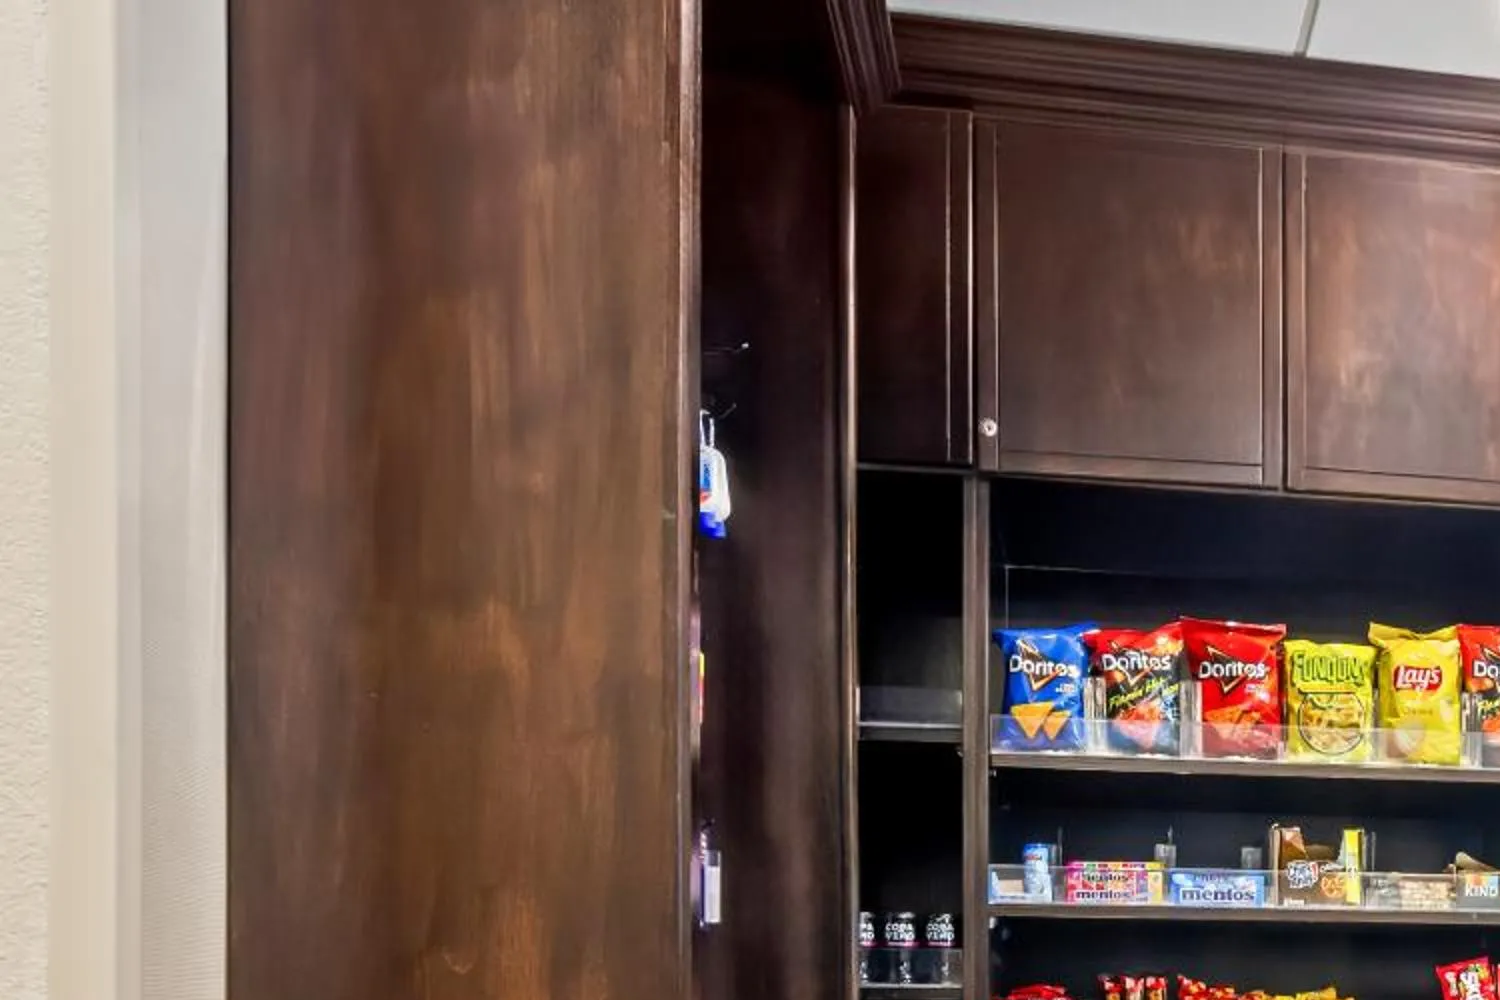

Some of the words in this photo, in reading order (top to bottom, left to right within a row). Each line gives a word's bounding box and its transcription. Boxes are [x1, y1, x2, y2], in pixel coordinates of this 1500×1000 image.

[1009, 654, 1080, 678] Doritos
[1102, 650, 1172, 672] Doritos
[1199, 658, 1268, 679] Doritos
[1181, 888, 1256, 901] mentos
[1464, 884, 1499, 898] KIND
